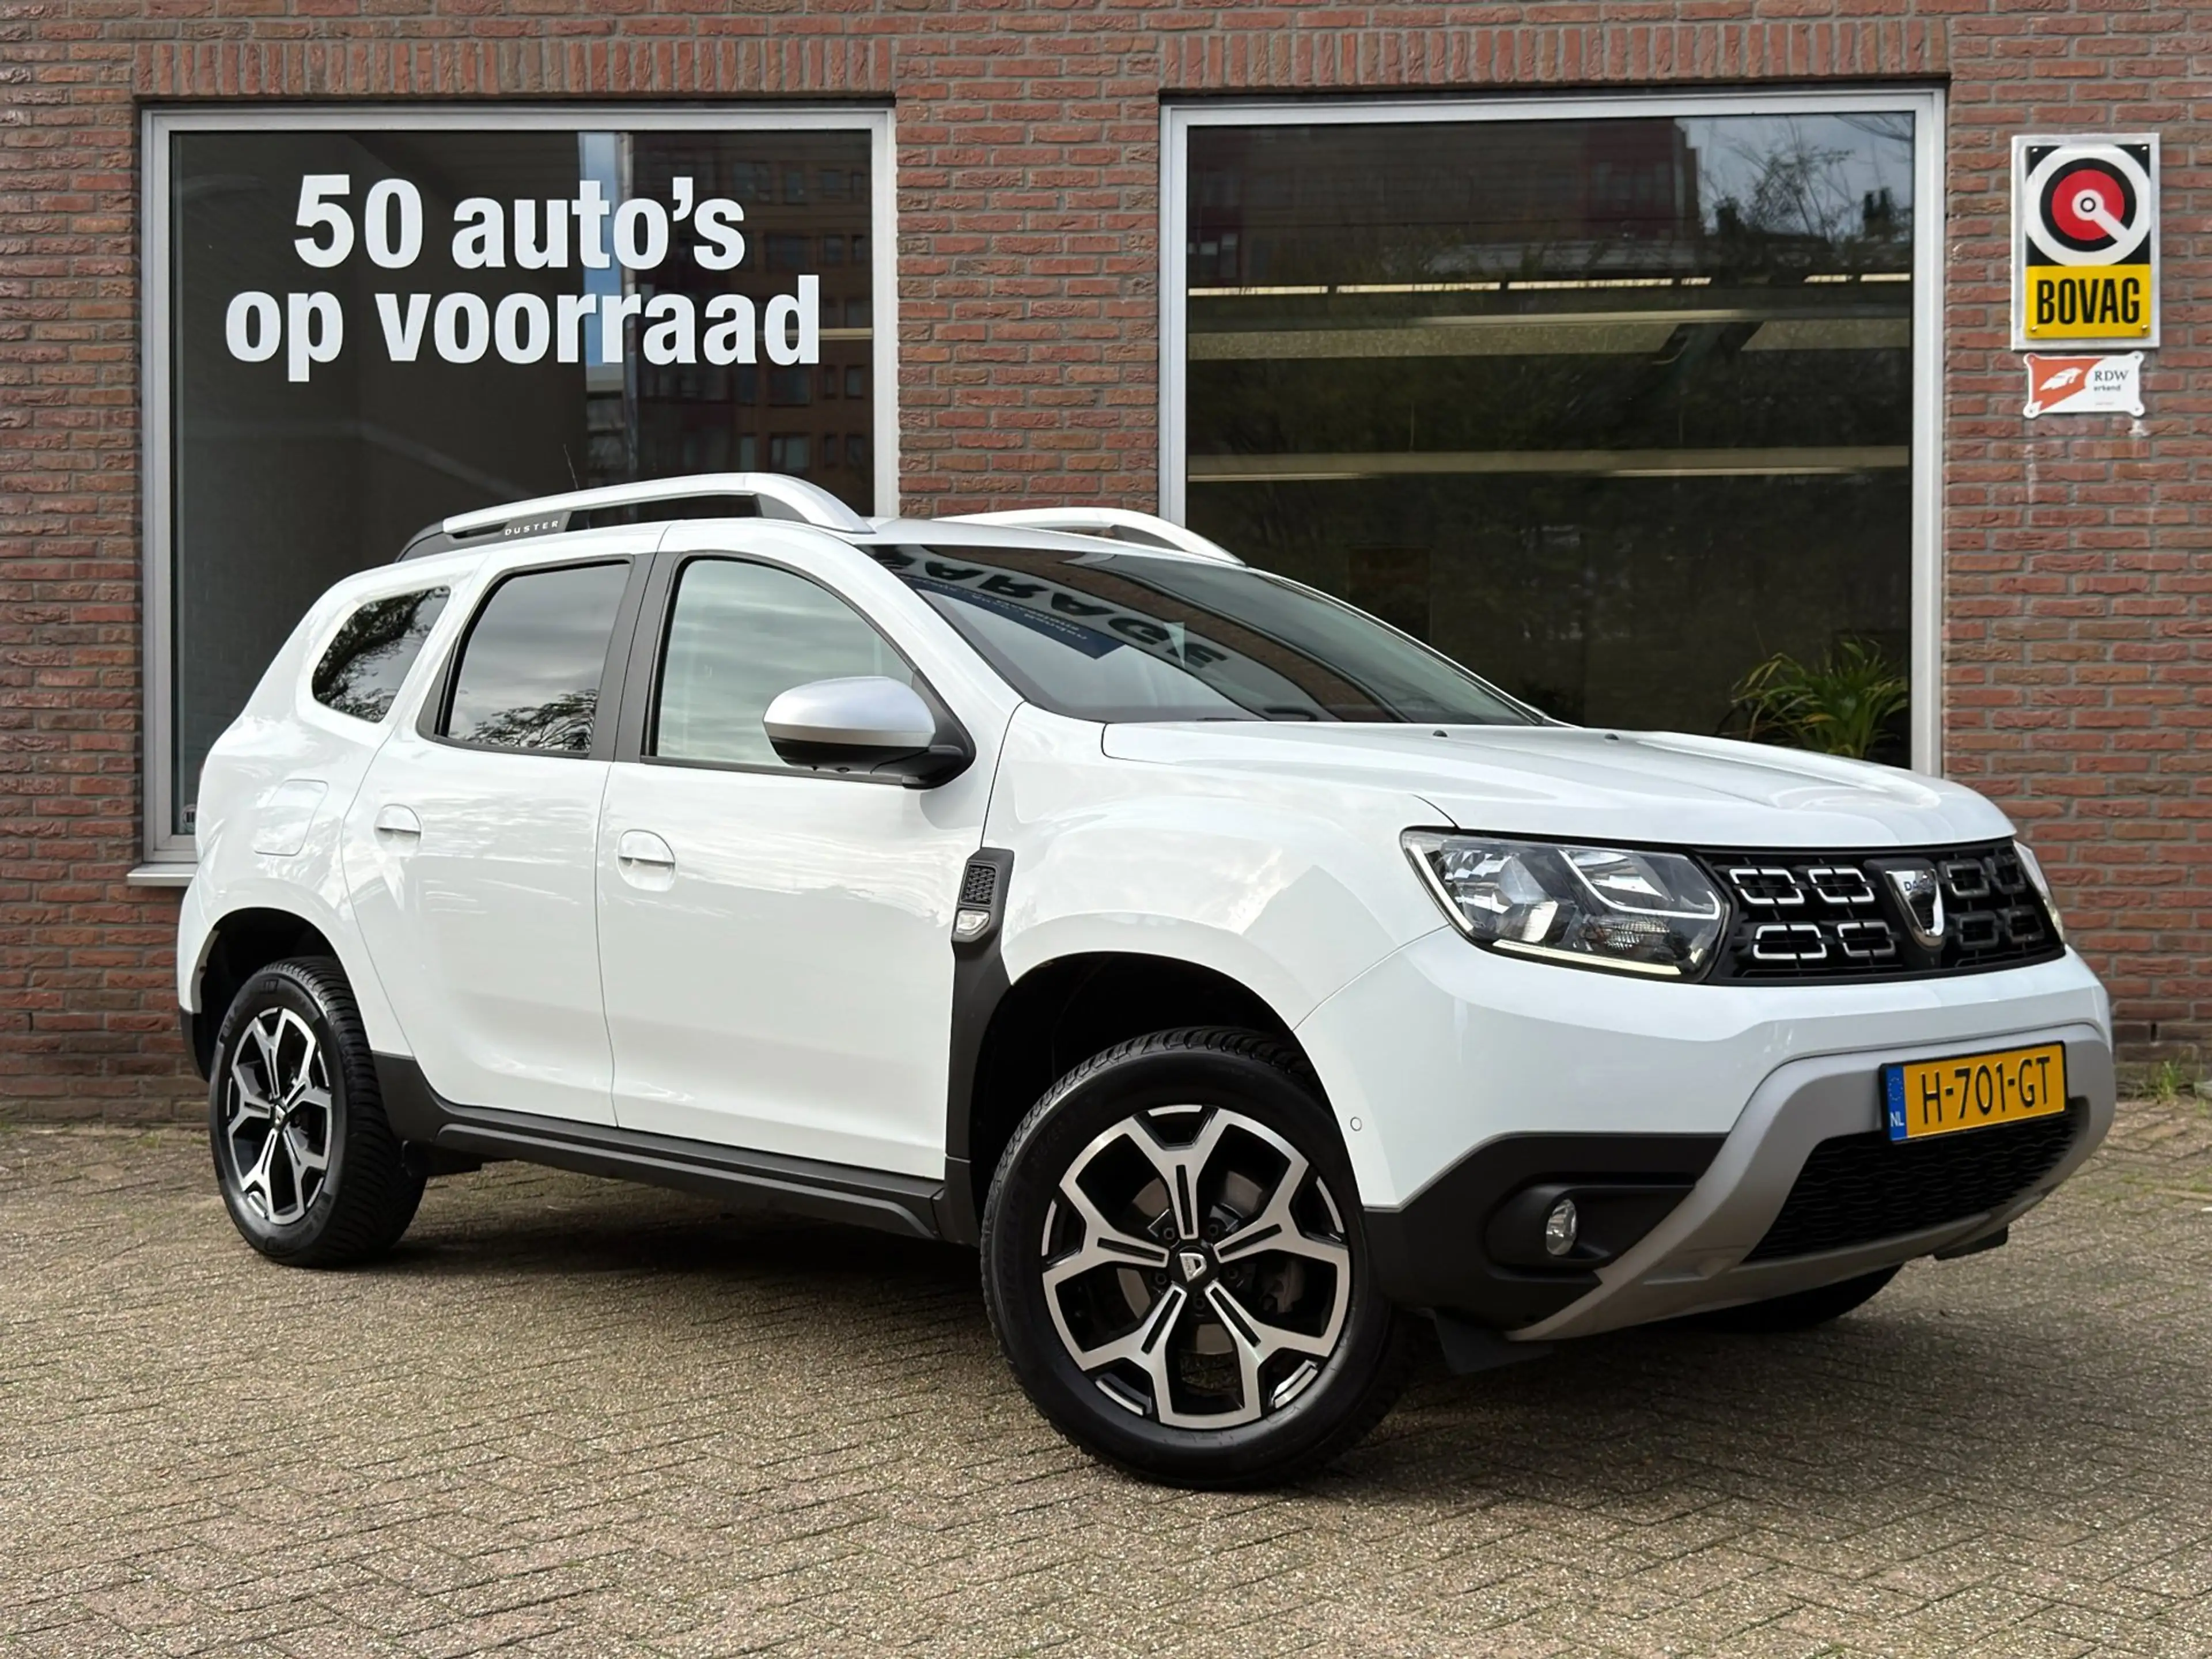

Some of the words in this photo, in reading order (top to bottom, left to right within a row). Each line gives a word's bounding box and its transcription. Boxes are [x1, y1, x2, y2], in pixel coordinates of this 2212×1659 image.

[294, 174, 423, 268] 50
[452, 177, 745, 270] auto's
[2037, 278, 2139, 325] BOVAG
[226, 291, 344, 382] op
[375, 275, 820, 365] voorraad
[2094, 369, 2129, 381] RDW
[505, 521, 559, 536] DUSTER
[1920, 1055, 2051, 1124] H-701-GT
[1889, 1112, 1905, 1127] NL
